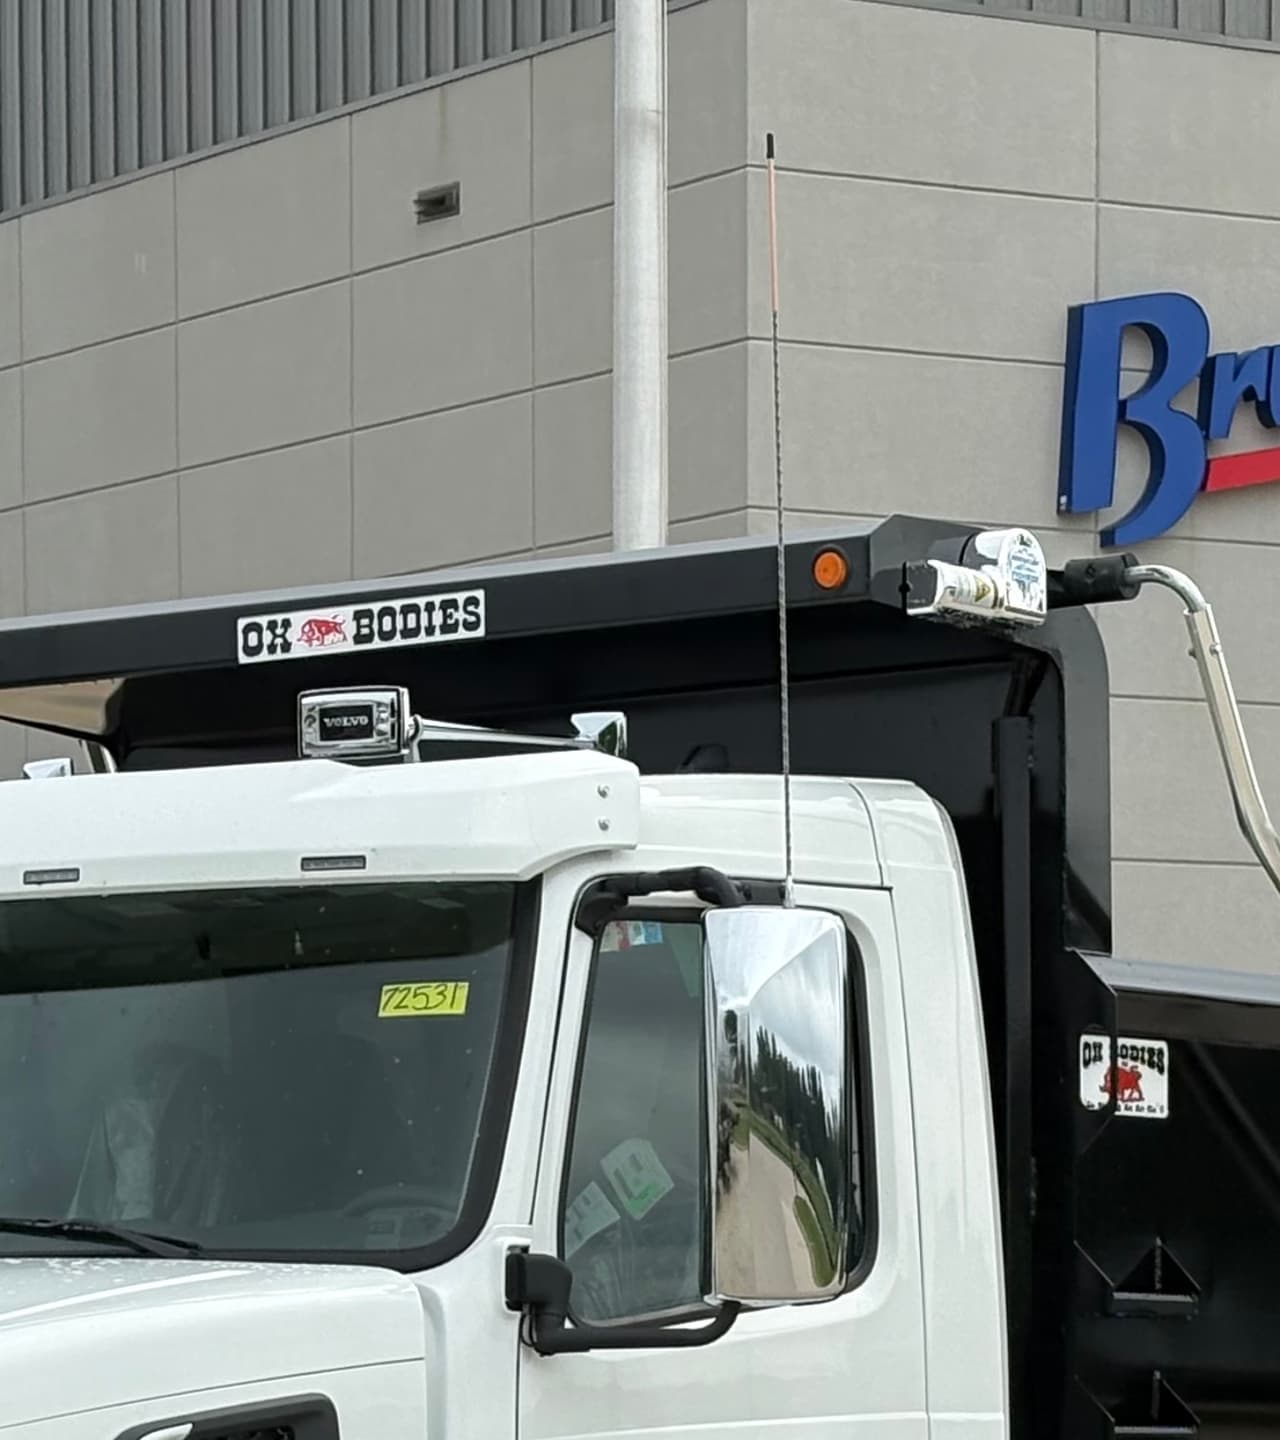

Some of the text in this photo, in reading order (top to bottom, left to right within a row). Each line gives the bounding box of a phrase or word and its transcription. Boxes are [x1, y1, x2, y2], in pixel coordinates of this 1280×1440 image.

[241, 595, 483, 660] OX BODIES
[322, 714, 369, 730] VOLVO
[381, 982, 459, 1013] 72531
[1082, 1040, 1166, 1076] OX ODIES
